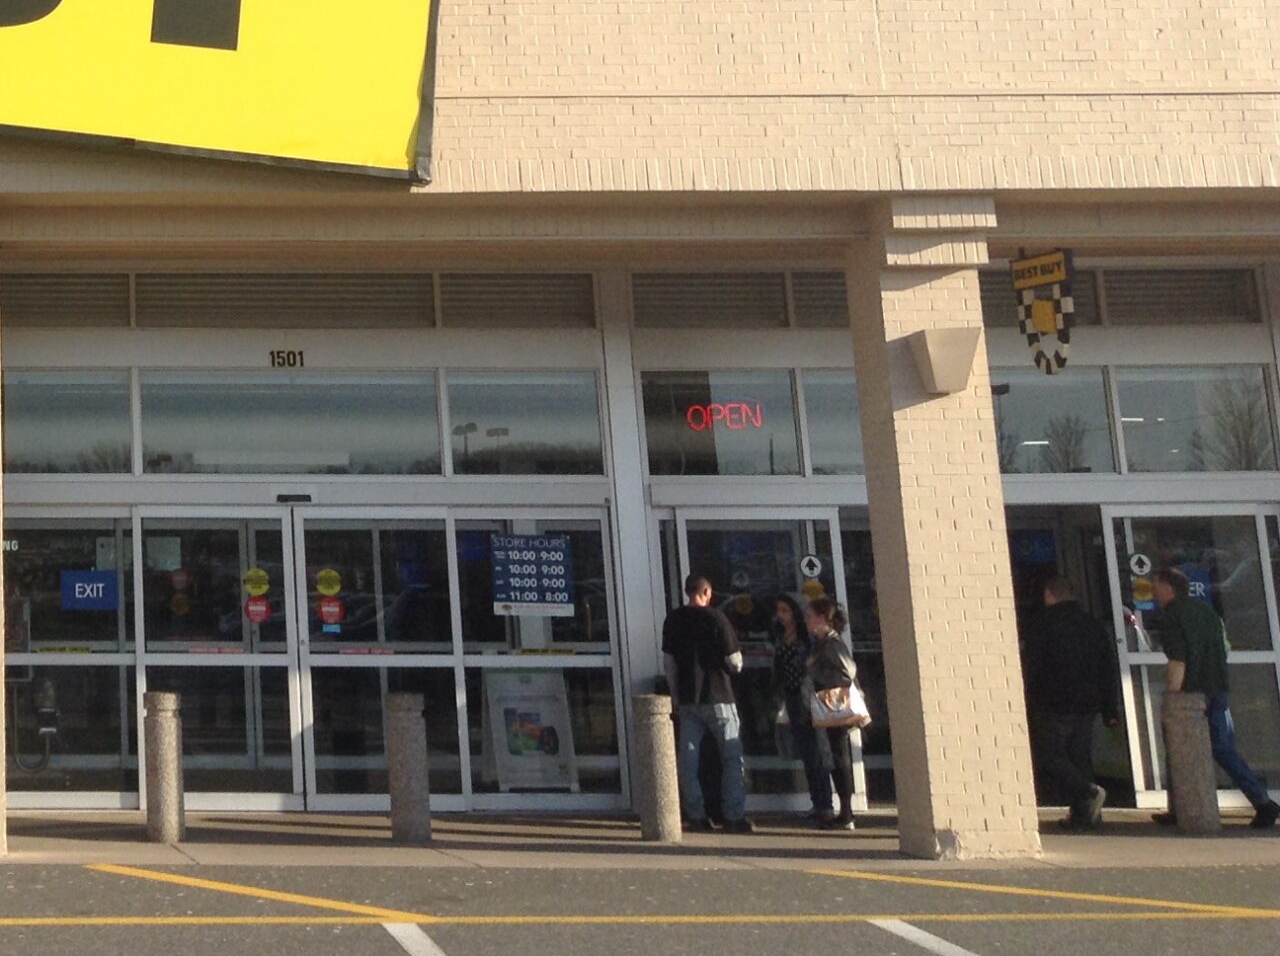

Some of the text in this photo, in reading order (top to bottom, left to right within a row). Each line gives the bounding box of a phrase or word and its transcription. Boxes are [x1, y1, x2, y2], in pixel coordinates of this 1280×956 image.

[1014, 260, 1062, 281] BEST BUY
[269, 350, 304, 367] 1501
[687, 402, 762, 431] OPEN
[2, 540, 19, 551] NG
[493, 537, 566, 548] STORE HOURS
[75, 583, 105, 598] EXIT
[1187, 581, 1206, 597] ER
